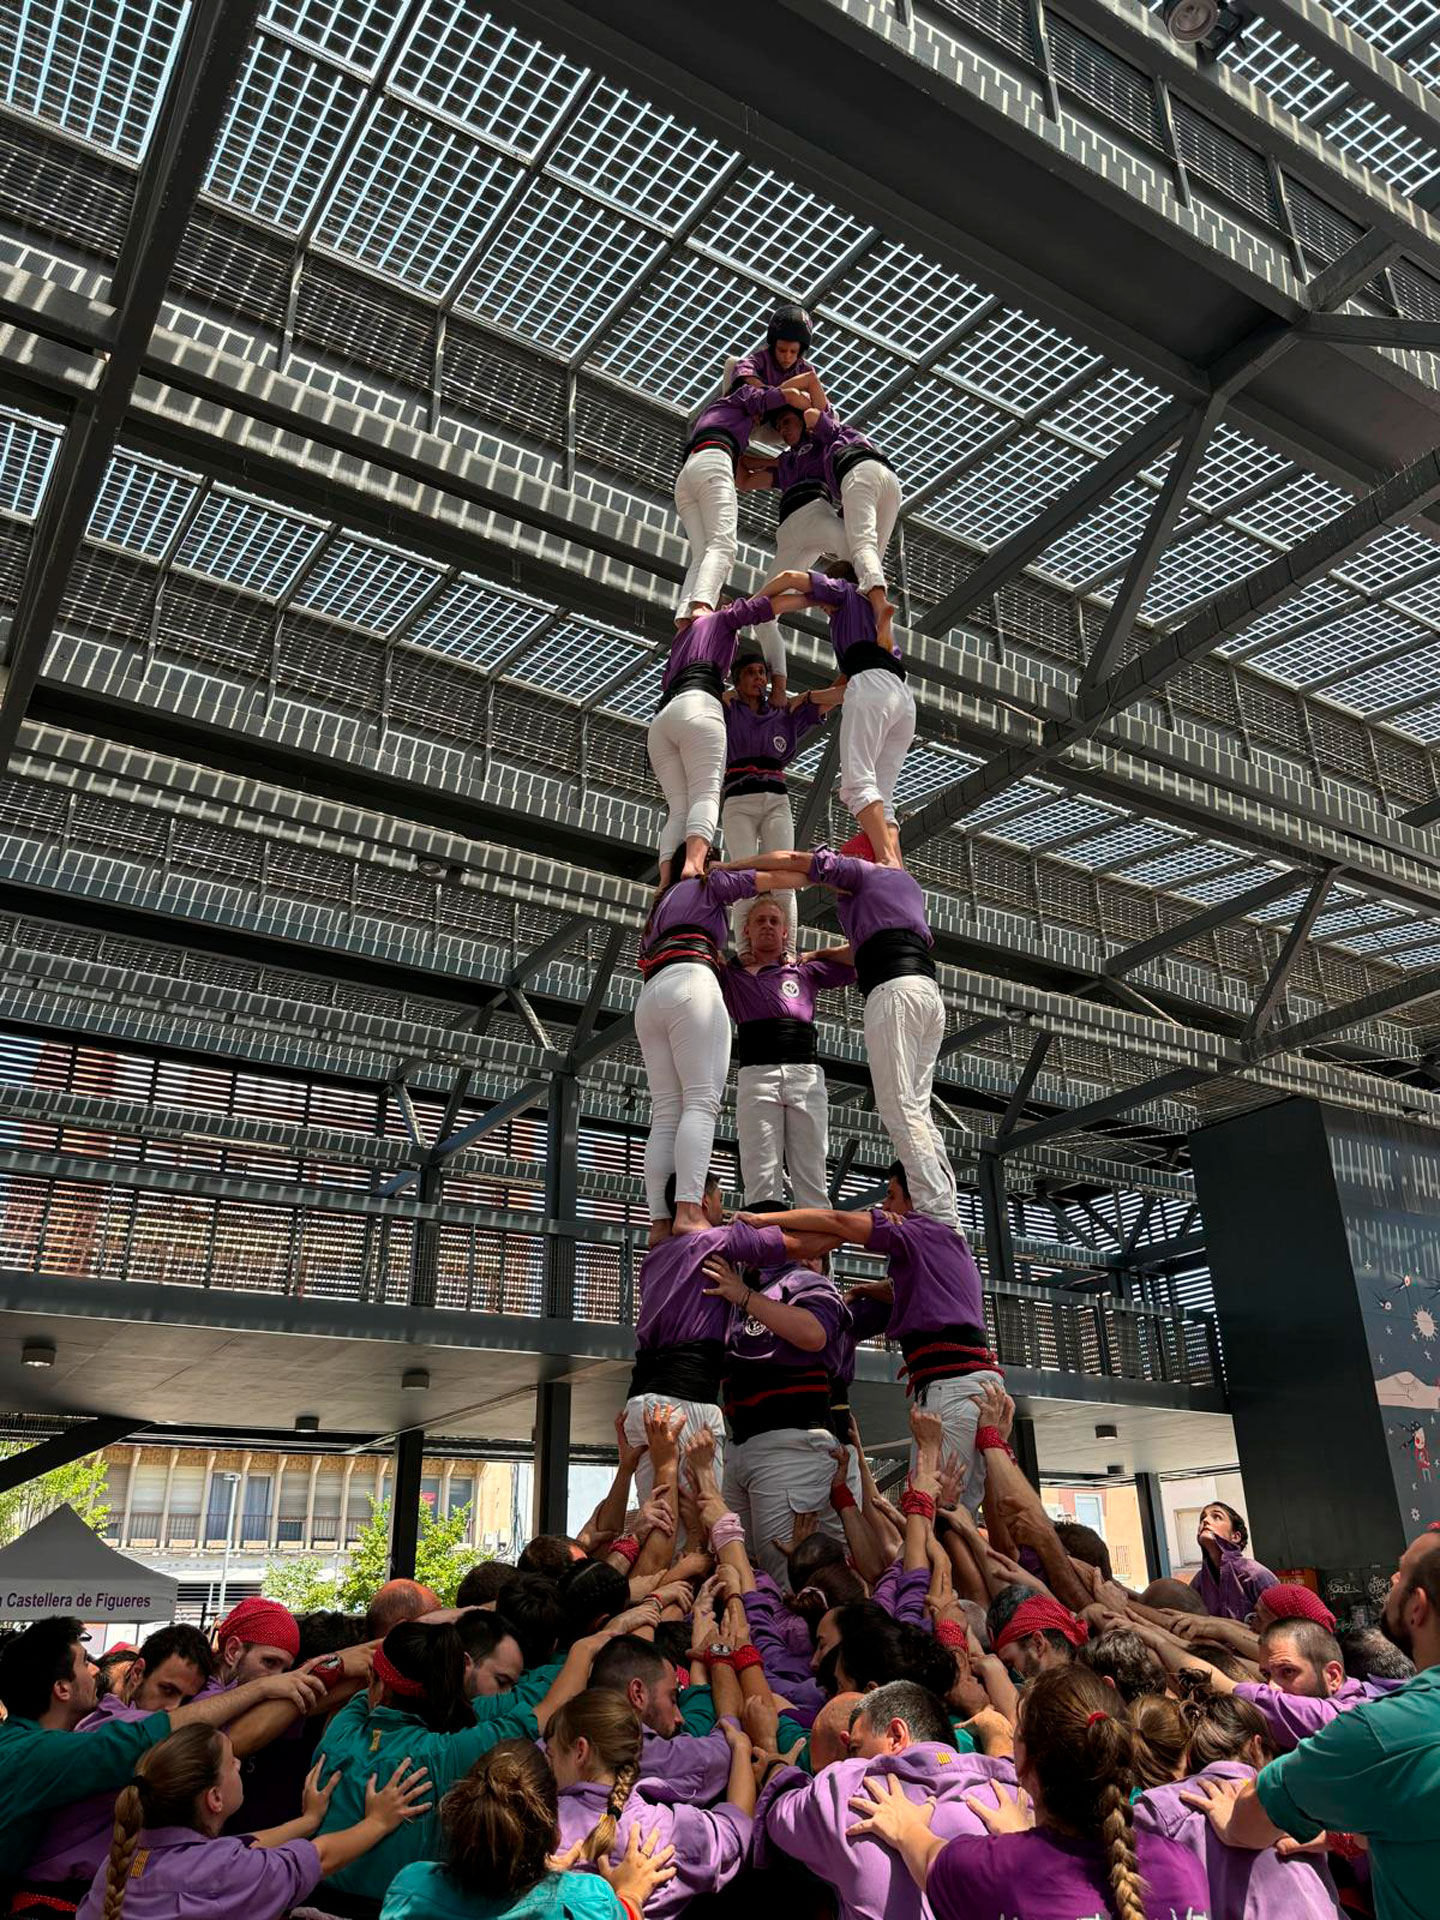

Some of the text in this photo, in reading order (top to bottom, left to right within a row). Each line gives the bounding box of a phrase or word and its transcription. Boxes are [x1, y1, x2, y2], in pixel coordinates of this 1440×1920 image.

[7, 1592, 73, 1608] Castellera
[76, 1593, 92, 1608] de
[96, 1593, 151, 1611] Figueres
